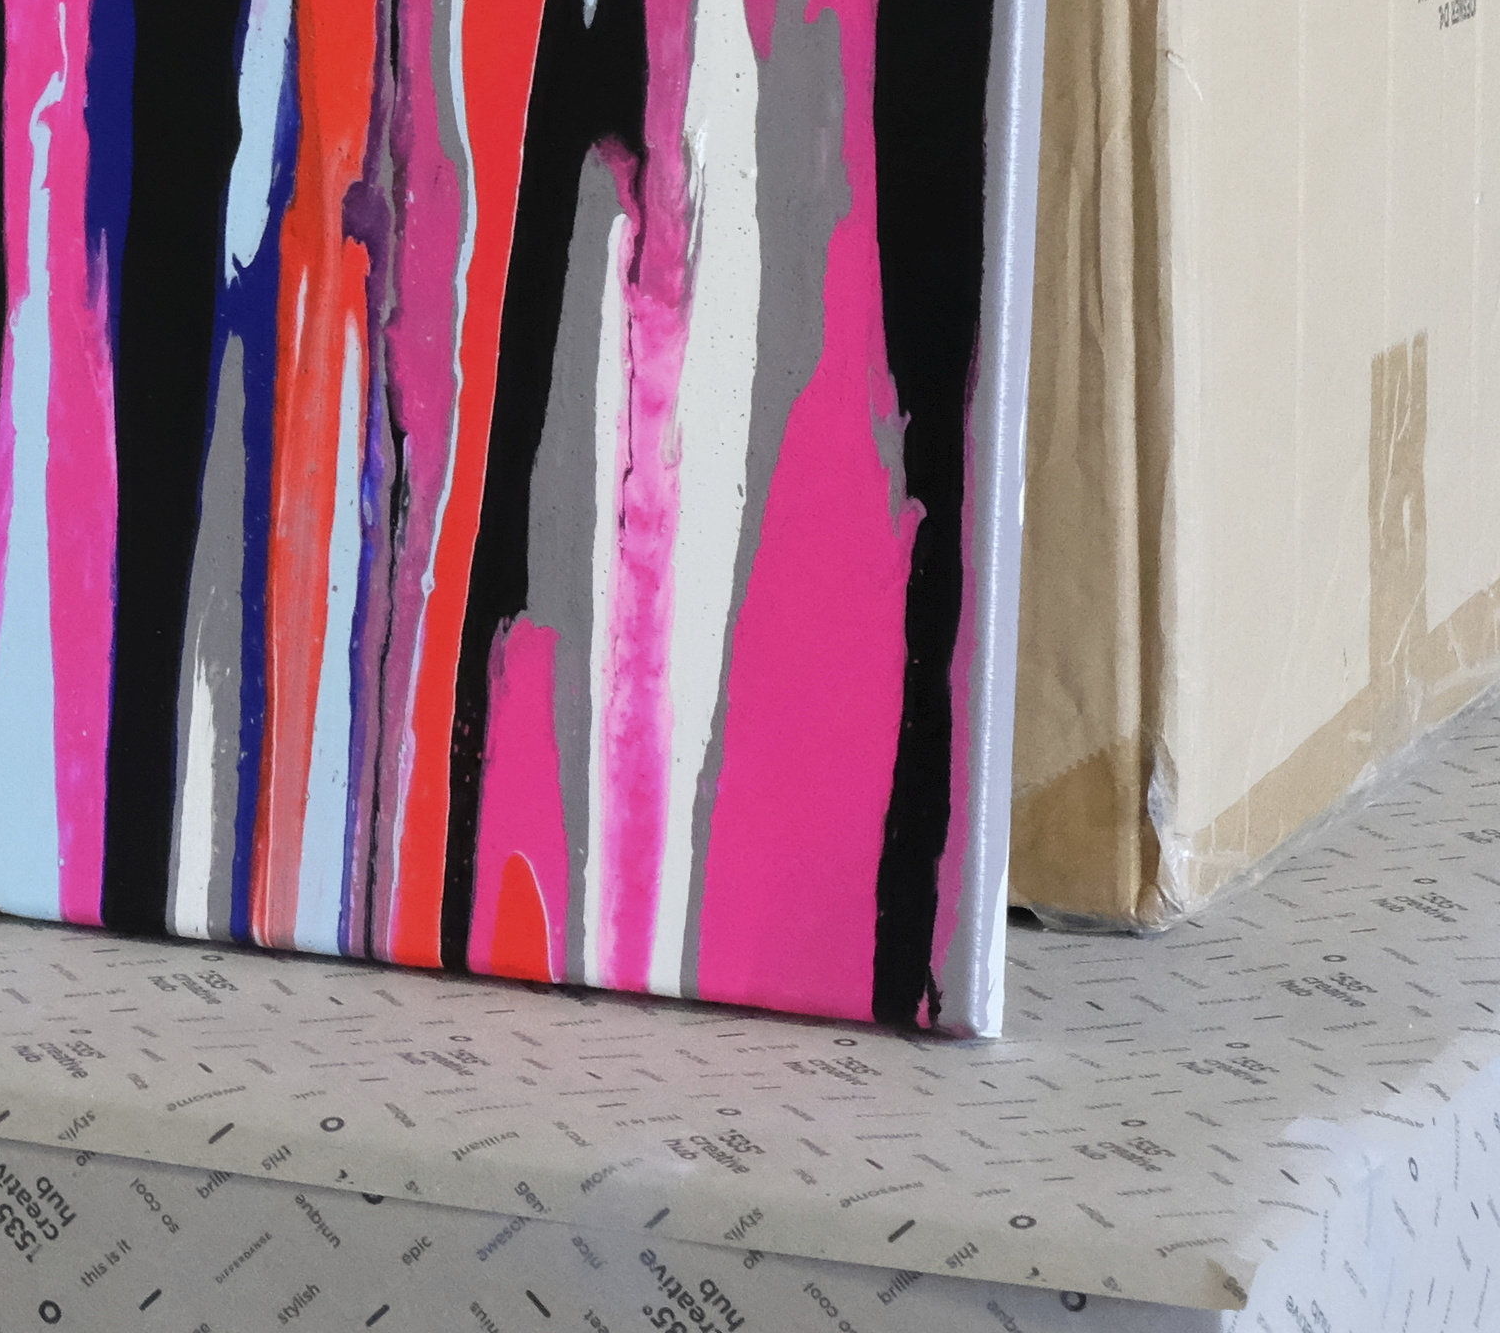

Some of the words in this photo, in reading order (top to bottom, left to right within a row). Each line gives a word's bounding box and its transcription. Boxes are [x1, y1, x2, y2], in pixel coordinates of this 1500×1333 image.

[451, 1131, 520, 1162] brilliant
[35, 1176, 76, 1227] hub
[839, 1181, 924, 1209] awesome
[214, 1231, 273, 1284] DIFFERDANGE
[400, 1236, 433, 1266] epic
[276, 1284, 321, 1326] stylish
